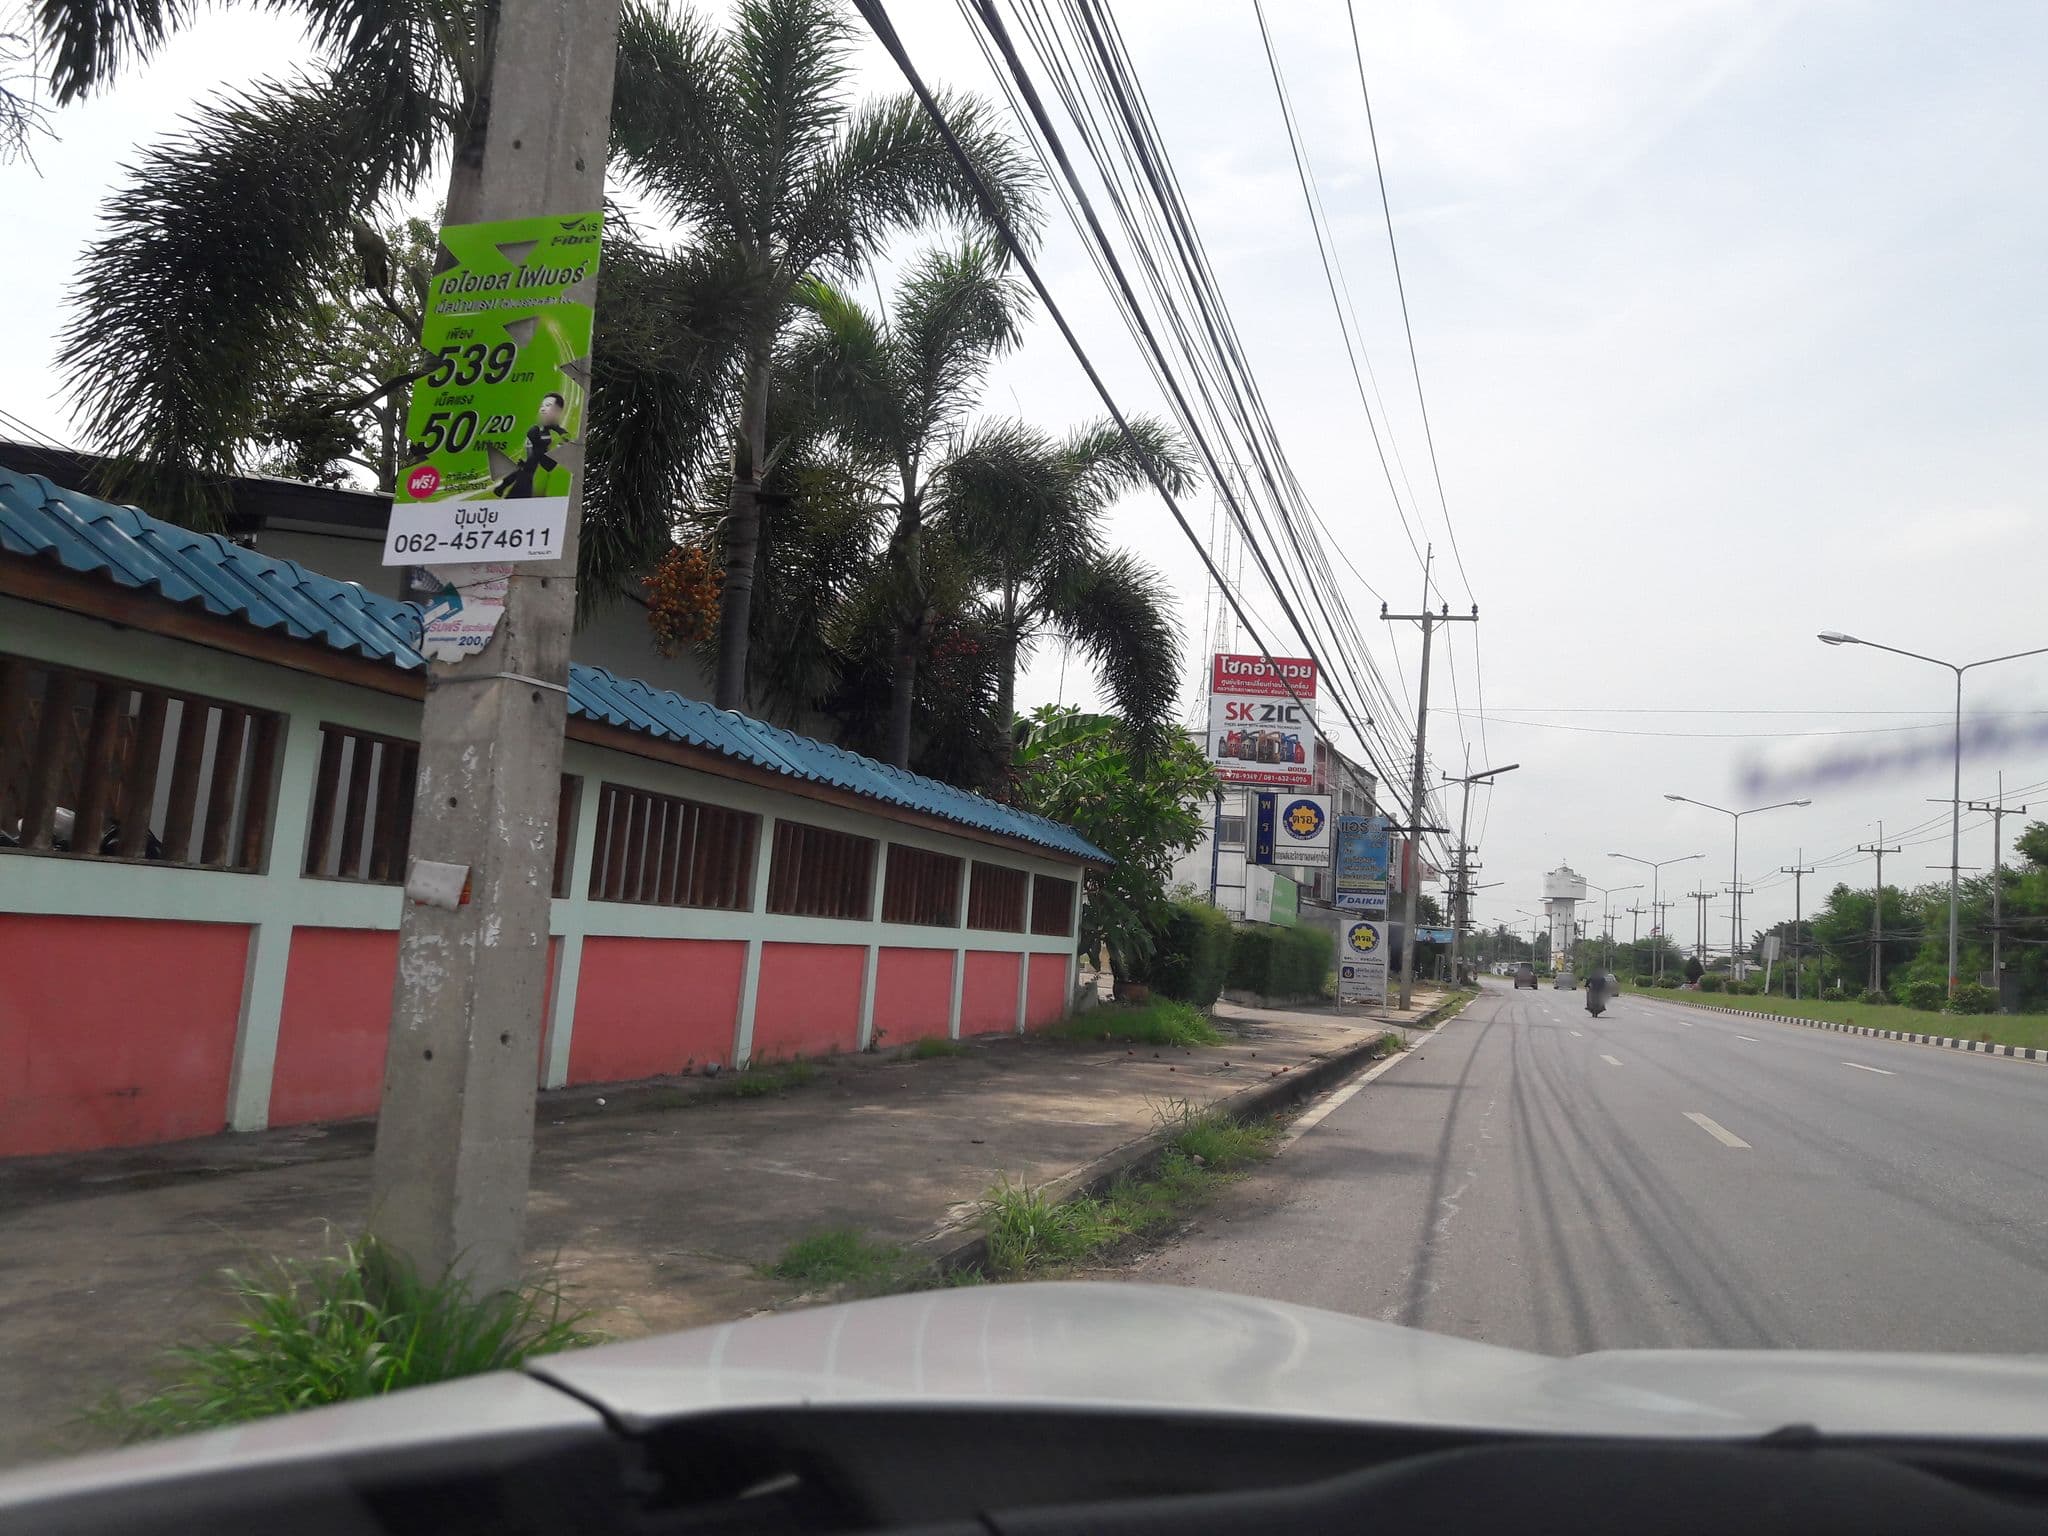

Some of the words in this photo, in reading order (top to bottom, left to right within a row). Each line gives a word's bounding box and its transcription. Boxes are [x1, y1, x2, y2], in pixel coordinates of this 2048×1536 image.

[579, 223, 598, 232] AIS
[551, 234, 597, 246] Fibre
[439, 269, 512, 295] เอไอเอส
[515, 259, 590, 289] ไฟเบอร์
[446, 327, 474, 340] เพียง
[427, 342, 518, 388] 539
[411, 474, 435, 490] ฟรี!
[394, 528, 551, 553] 062-4574611
[1221, 656, 1311, 679] โชคอำนวย
[1225, 702, 1254, 721] SK
[1259, 704, 1301, 724] ZIC
[1347, 896, 1385, 905] DAIKIN
